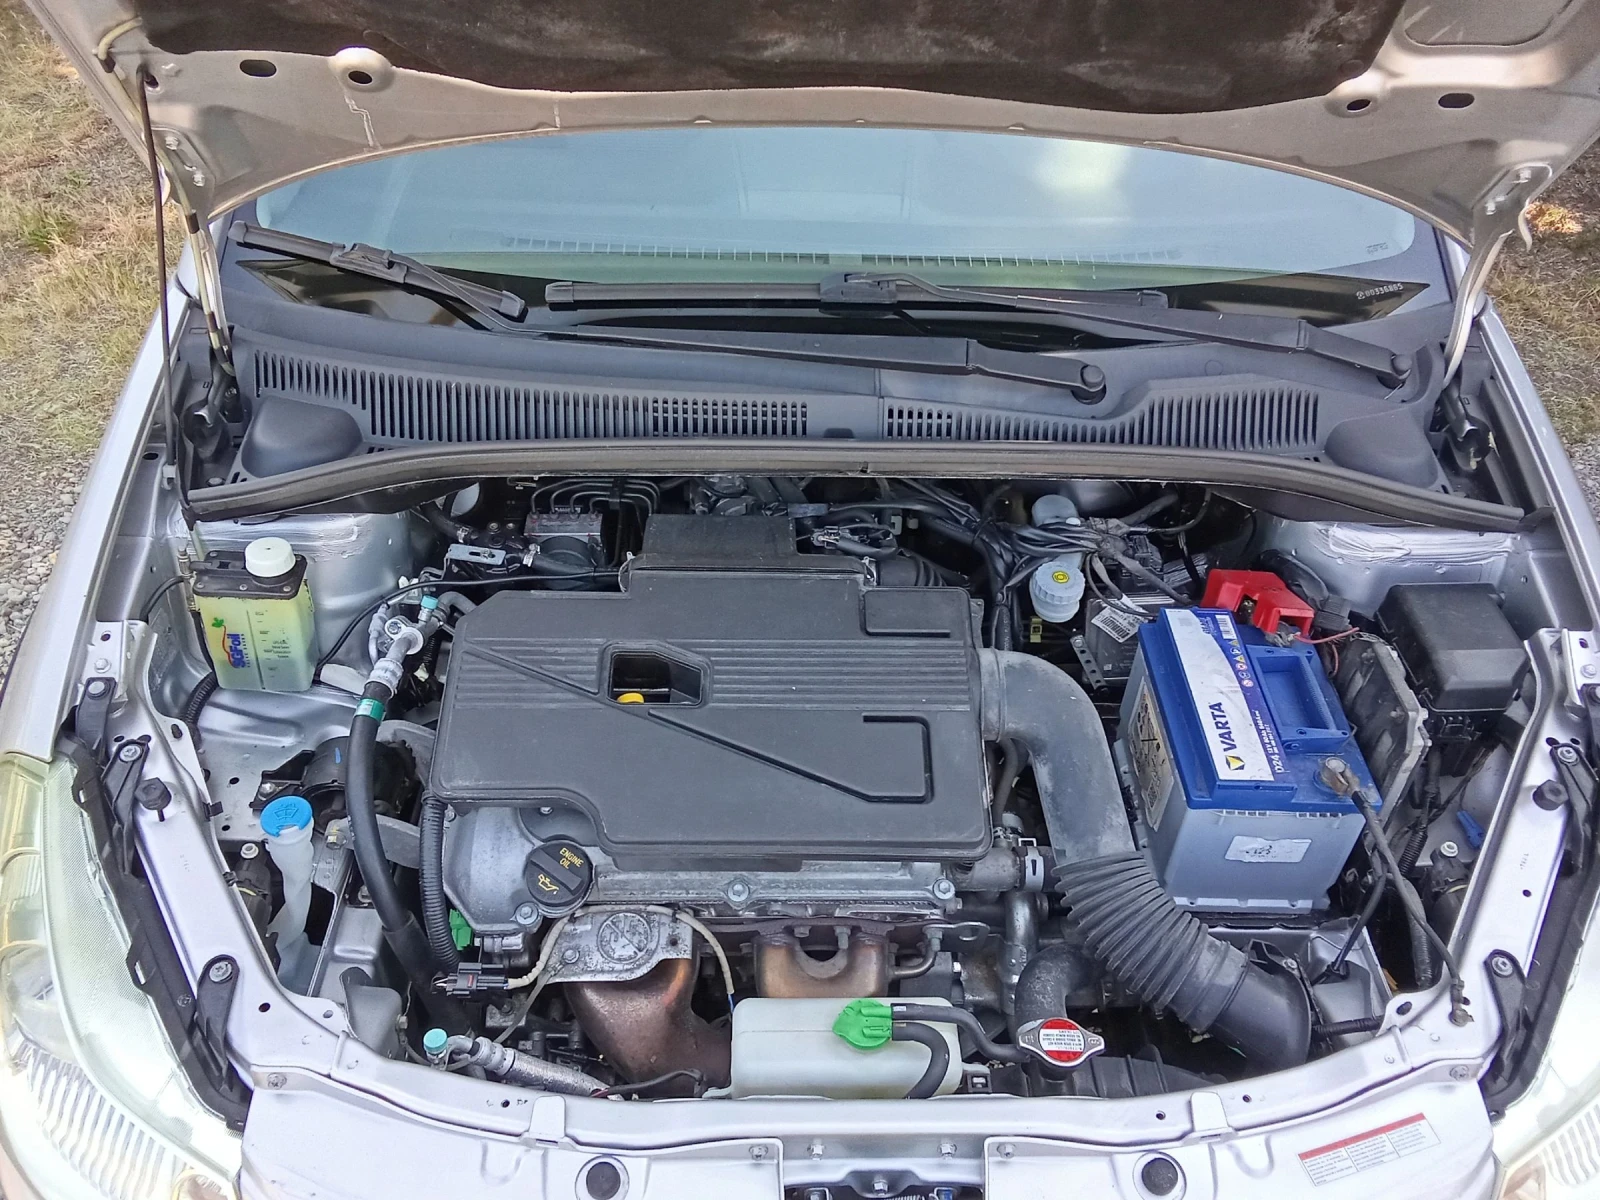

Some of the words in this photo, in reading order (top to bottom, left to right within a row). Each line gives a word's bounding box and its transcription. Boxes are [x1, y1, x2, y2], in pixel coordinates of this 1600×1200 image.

[1209, 702, 1237, 752] VARTA
[1271, 755, 1285, 773] D24
[560, 847, 584, 867] ENGINE
[560, 858, 570, 869] OIL
